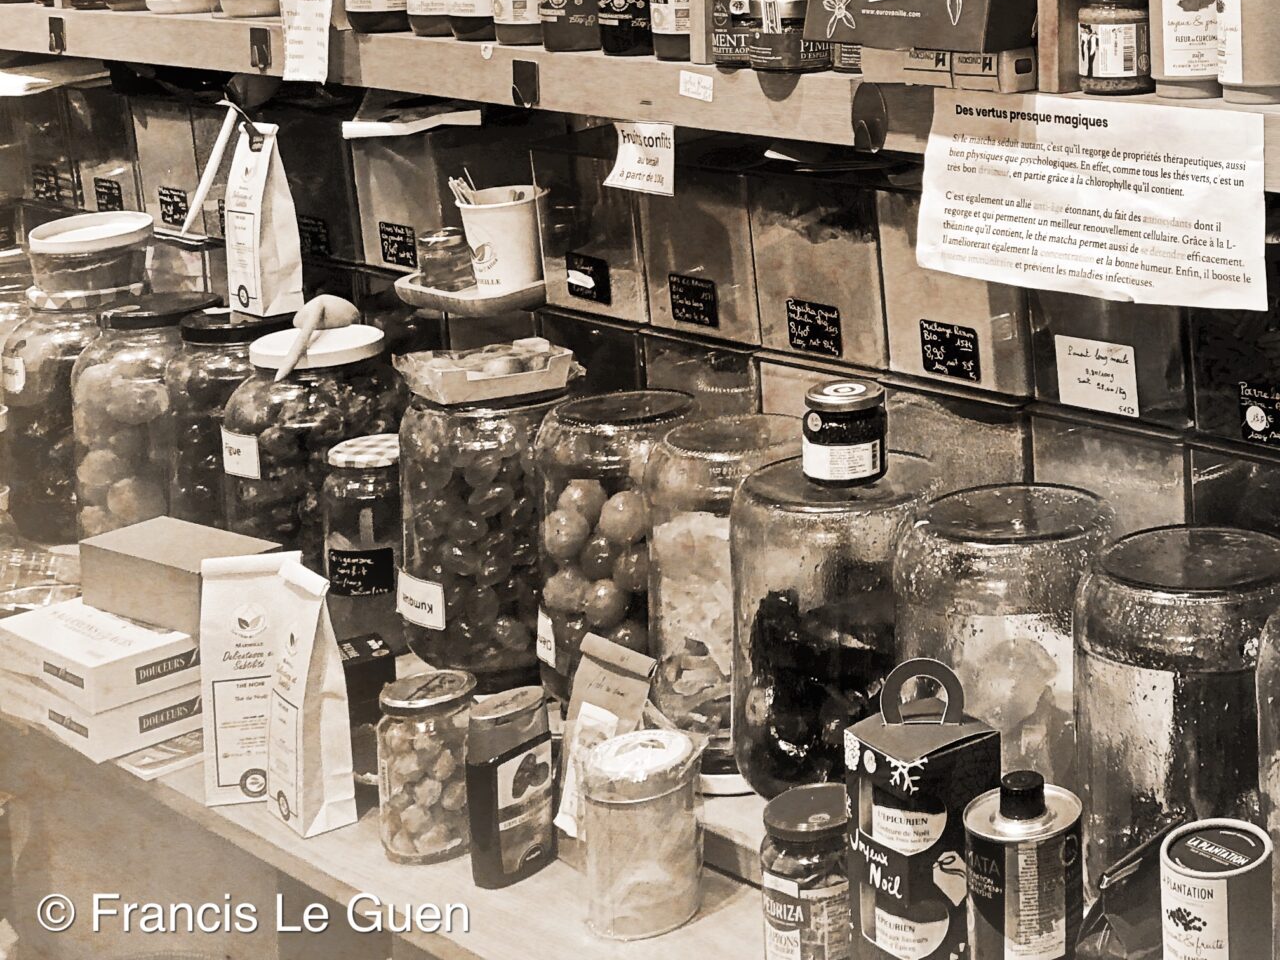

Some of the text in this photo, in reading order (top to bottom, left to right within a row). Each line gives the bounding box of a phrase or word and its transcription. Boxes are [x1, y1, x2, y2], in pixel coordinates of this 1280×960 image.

[956, 105, 1108, 129] Des vertus presque magiques
[621, 129, 671, 149] Fruits confits
[1020, 154, 1078, 170] psychologiques.
[1082, 148, 1246, 170] regorge aussi
[1024, 172, 1046, 183] partie
[1113, 167, 1158, 178] comme tous
[1086, 178, 1131, 192] chlorophylle
[1151, 185, 1184, 196] contient.
[1065, 205, 1101, 219] étonnant,
[1115, 210, 1141, 222] fait des
[995, 213, 1081, 230] permettent meilleur
[1049, 234, 1077, 245] matcha
[1083, 224, 1207, 246] renouvellement cellulaire. Grâce
[1187, 251, 1245, 267] efficacement.
[1068, 267, 1103, 280] maladies
[1115, 259, 1202, 279] bonne humeur. Enfin,
[1212, 272, 1240, 282] booste
[1106, 274, 1154, 288] infectieuses.
[139, 657, 185, 680] DOUCEURS
[142, 708, 188, 731] DOUCEURS
[850, 827, 889, 867] Joyeux
[1201, 842, 1249, 865] PLANTATION
[869, 863, 902, 899] Noël
